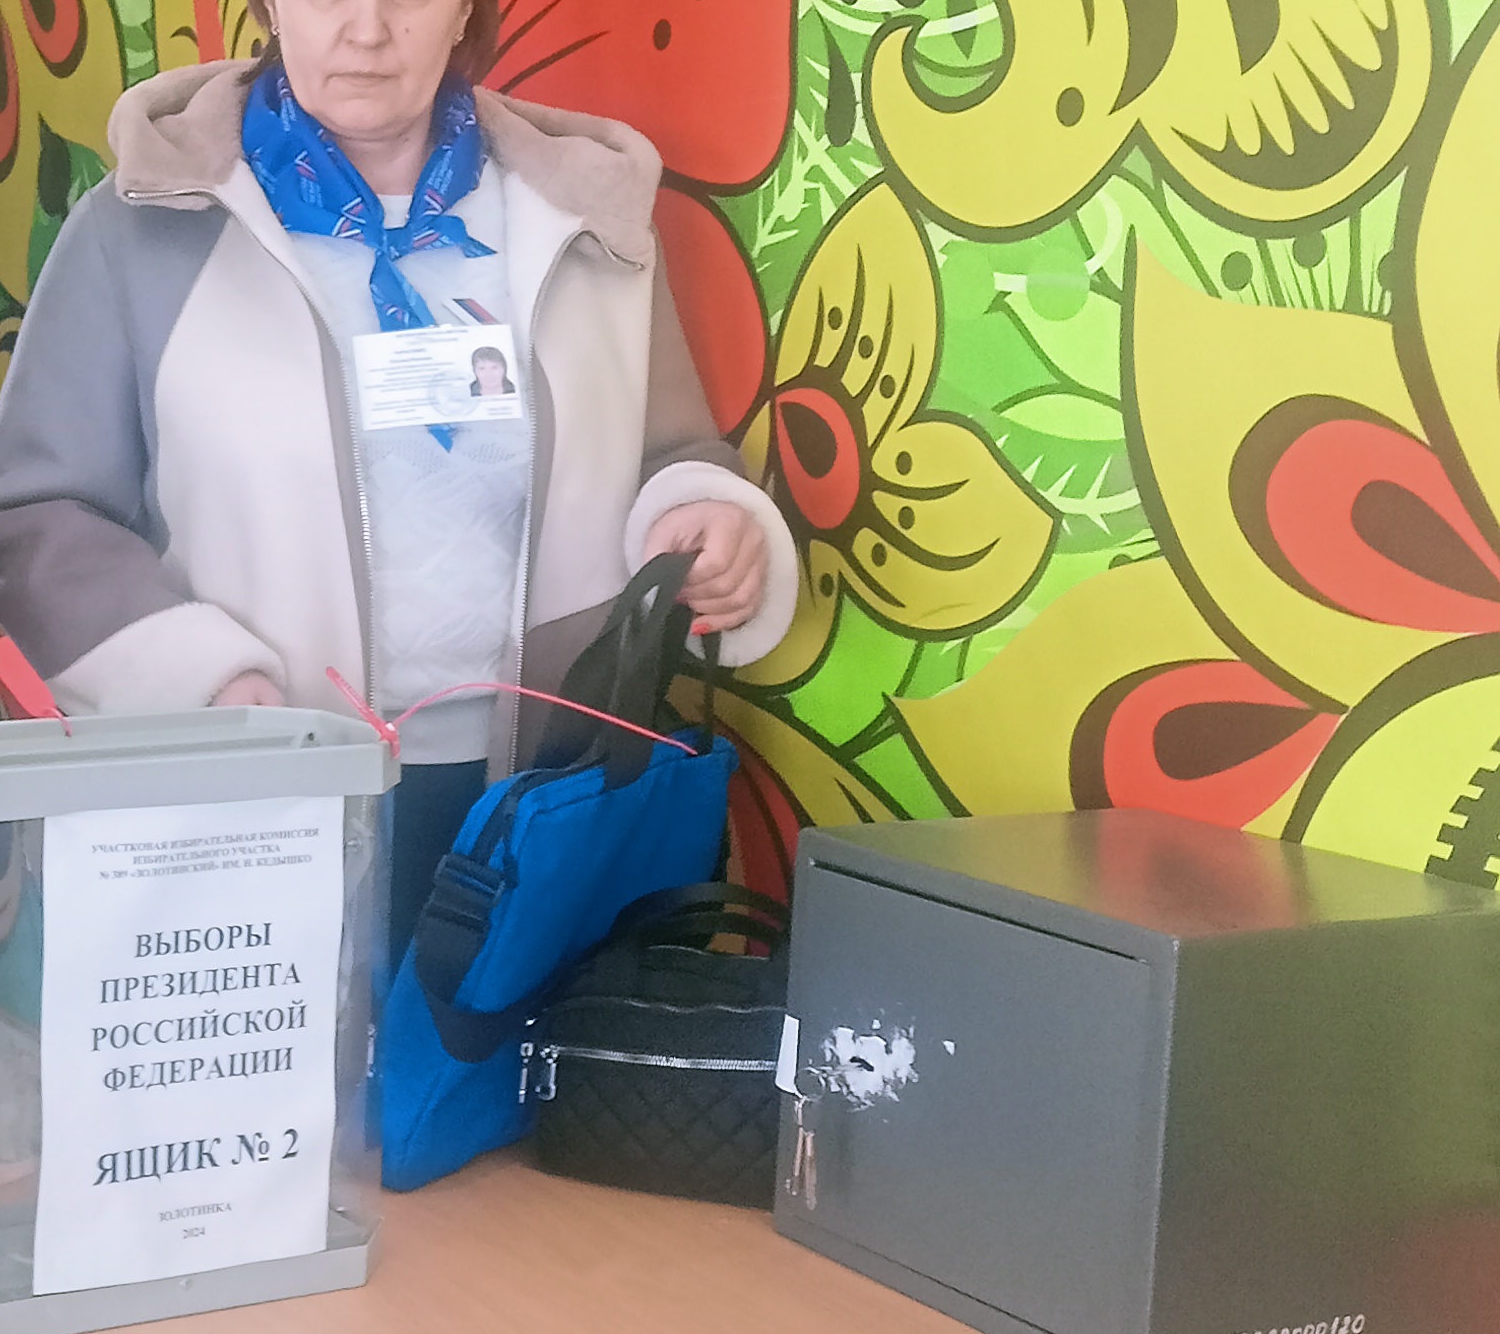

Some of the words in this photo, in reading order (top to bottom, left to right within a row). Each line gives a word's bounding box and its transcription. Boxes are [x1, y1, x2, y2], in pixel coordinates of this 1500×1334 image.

[91, 840, 168, 854] УЧАСТКОВАЯ
[169, 832, 257, 849] ИЗБИРАТЕЛЬНАЯ
[259, 827, 320, 841] КОМИССИЯ
[132, 848, 230, 865] ИЗБИРАТЕЛЬНОГО
[231, 844, 281, 856] УЧАСТКА
[133, 922, 273, 959] ВЫБОРЫ
[99, 962, 302, 1005] ПРЕЗИДЕНТА
[90, 998, 308, 1053] РОССИЙСКОЙ
[102, 1046, 295, 1093] ФЕДЕРАЦИИ
[91, 1136, 222, 1187] ЯЩИК
[231, 1131, 270, 1166] №
[281, 1127, 300, 1160] 2
[158, 1202, 233, 1223] ЗОЛОТИНКА
